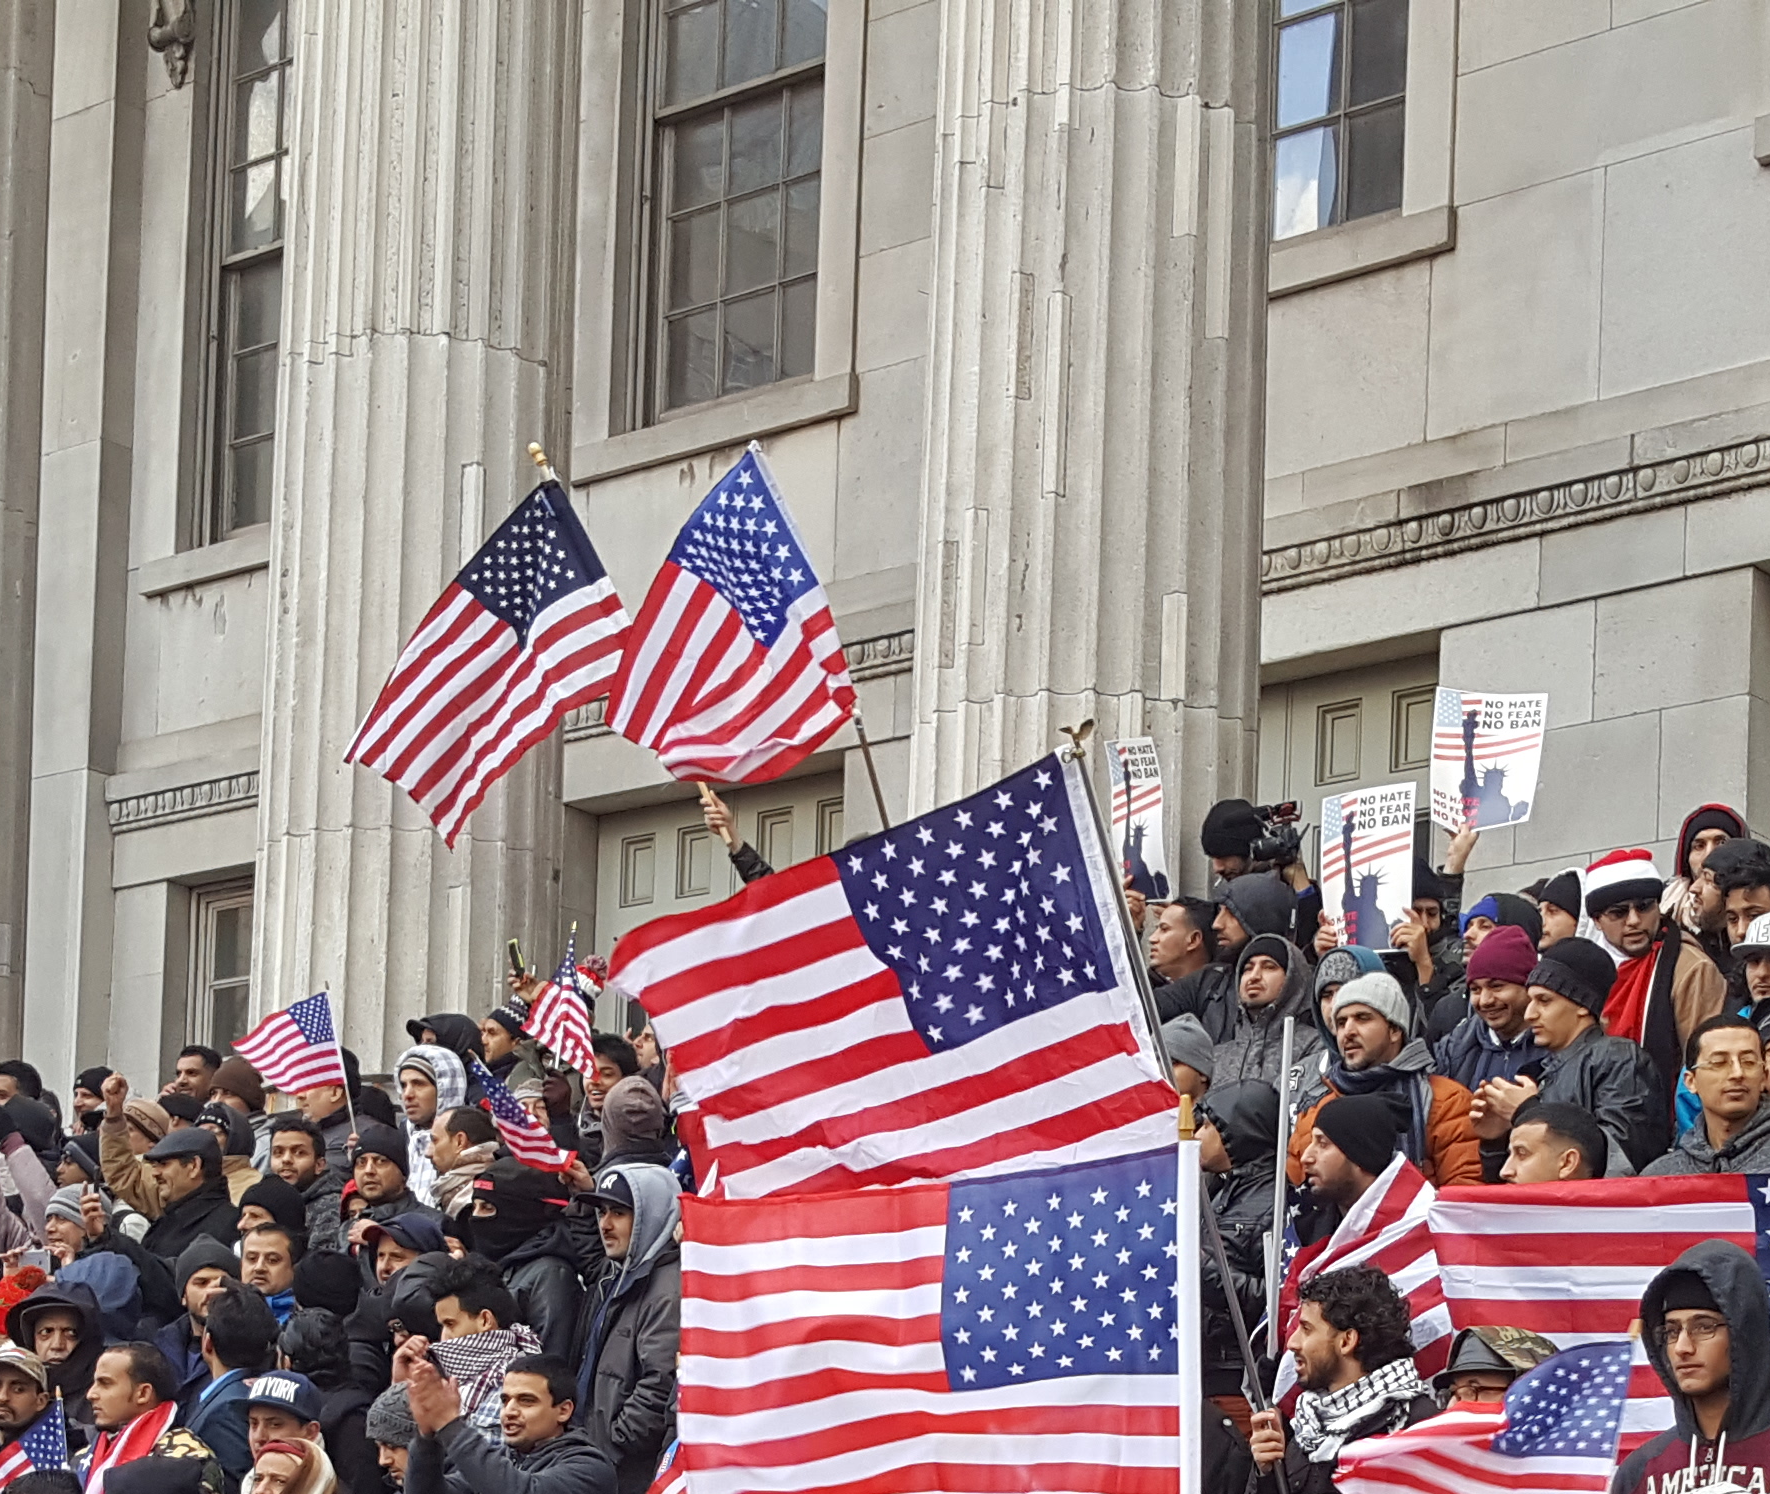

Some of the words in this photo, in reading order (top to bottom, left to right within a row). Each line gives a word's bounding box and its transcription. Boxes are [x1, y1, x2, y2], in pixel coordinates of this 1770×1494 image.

[1485, 700, 1504, 709] NO
[1508, 699, 1543, 709] HATE
[1484, 711, 1503, 719] NO
[1508, 709, 1542, 719] FEAR
[1482, 720, 1504, 730] NO
[1509, 719, 1542, 730] BAN
[1360, 795, 1376, 807] NO
[1379, 790, 1411, 804] HATE
[1359, 807, 1376, 818] NO
[1379, 802, 1411, 816] FEAR
[1357, 818, 1377, 831] NO
[1381, 812, 1411, 828] BAN
[264, 1376, 300, 1403] YORK
